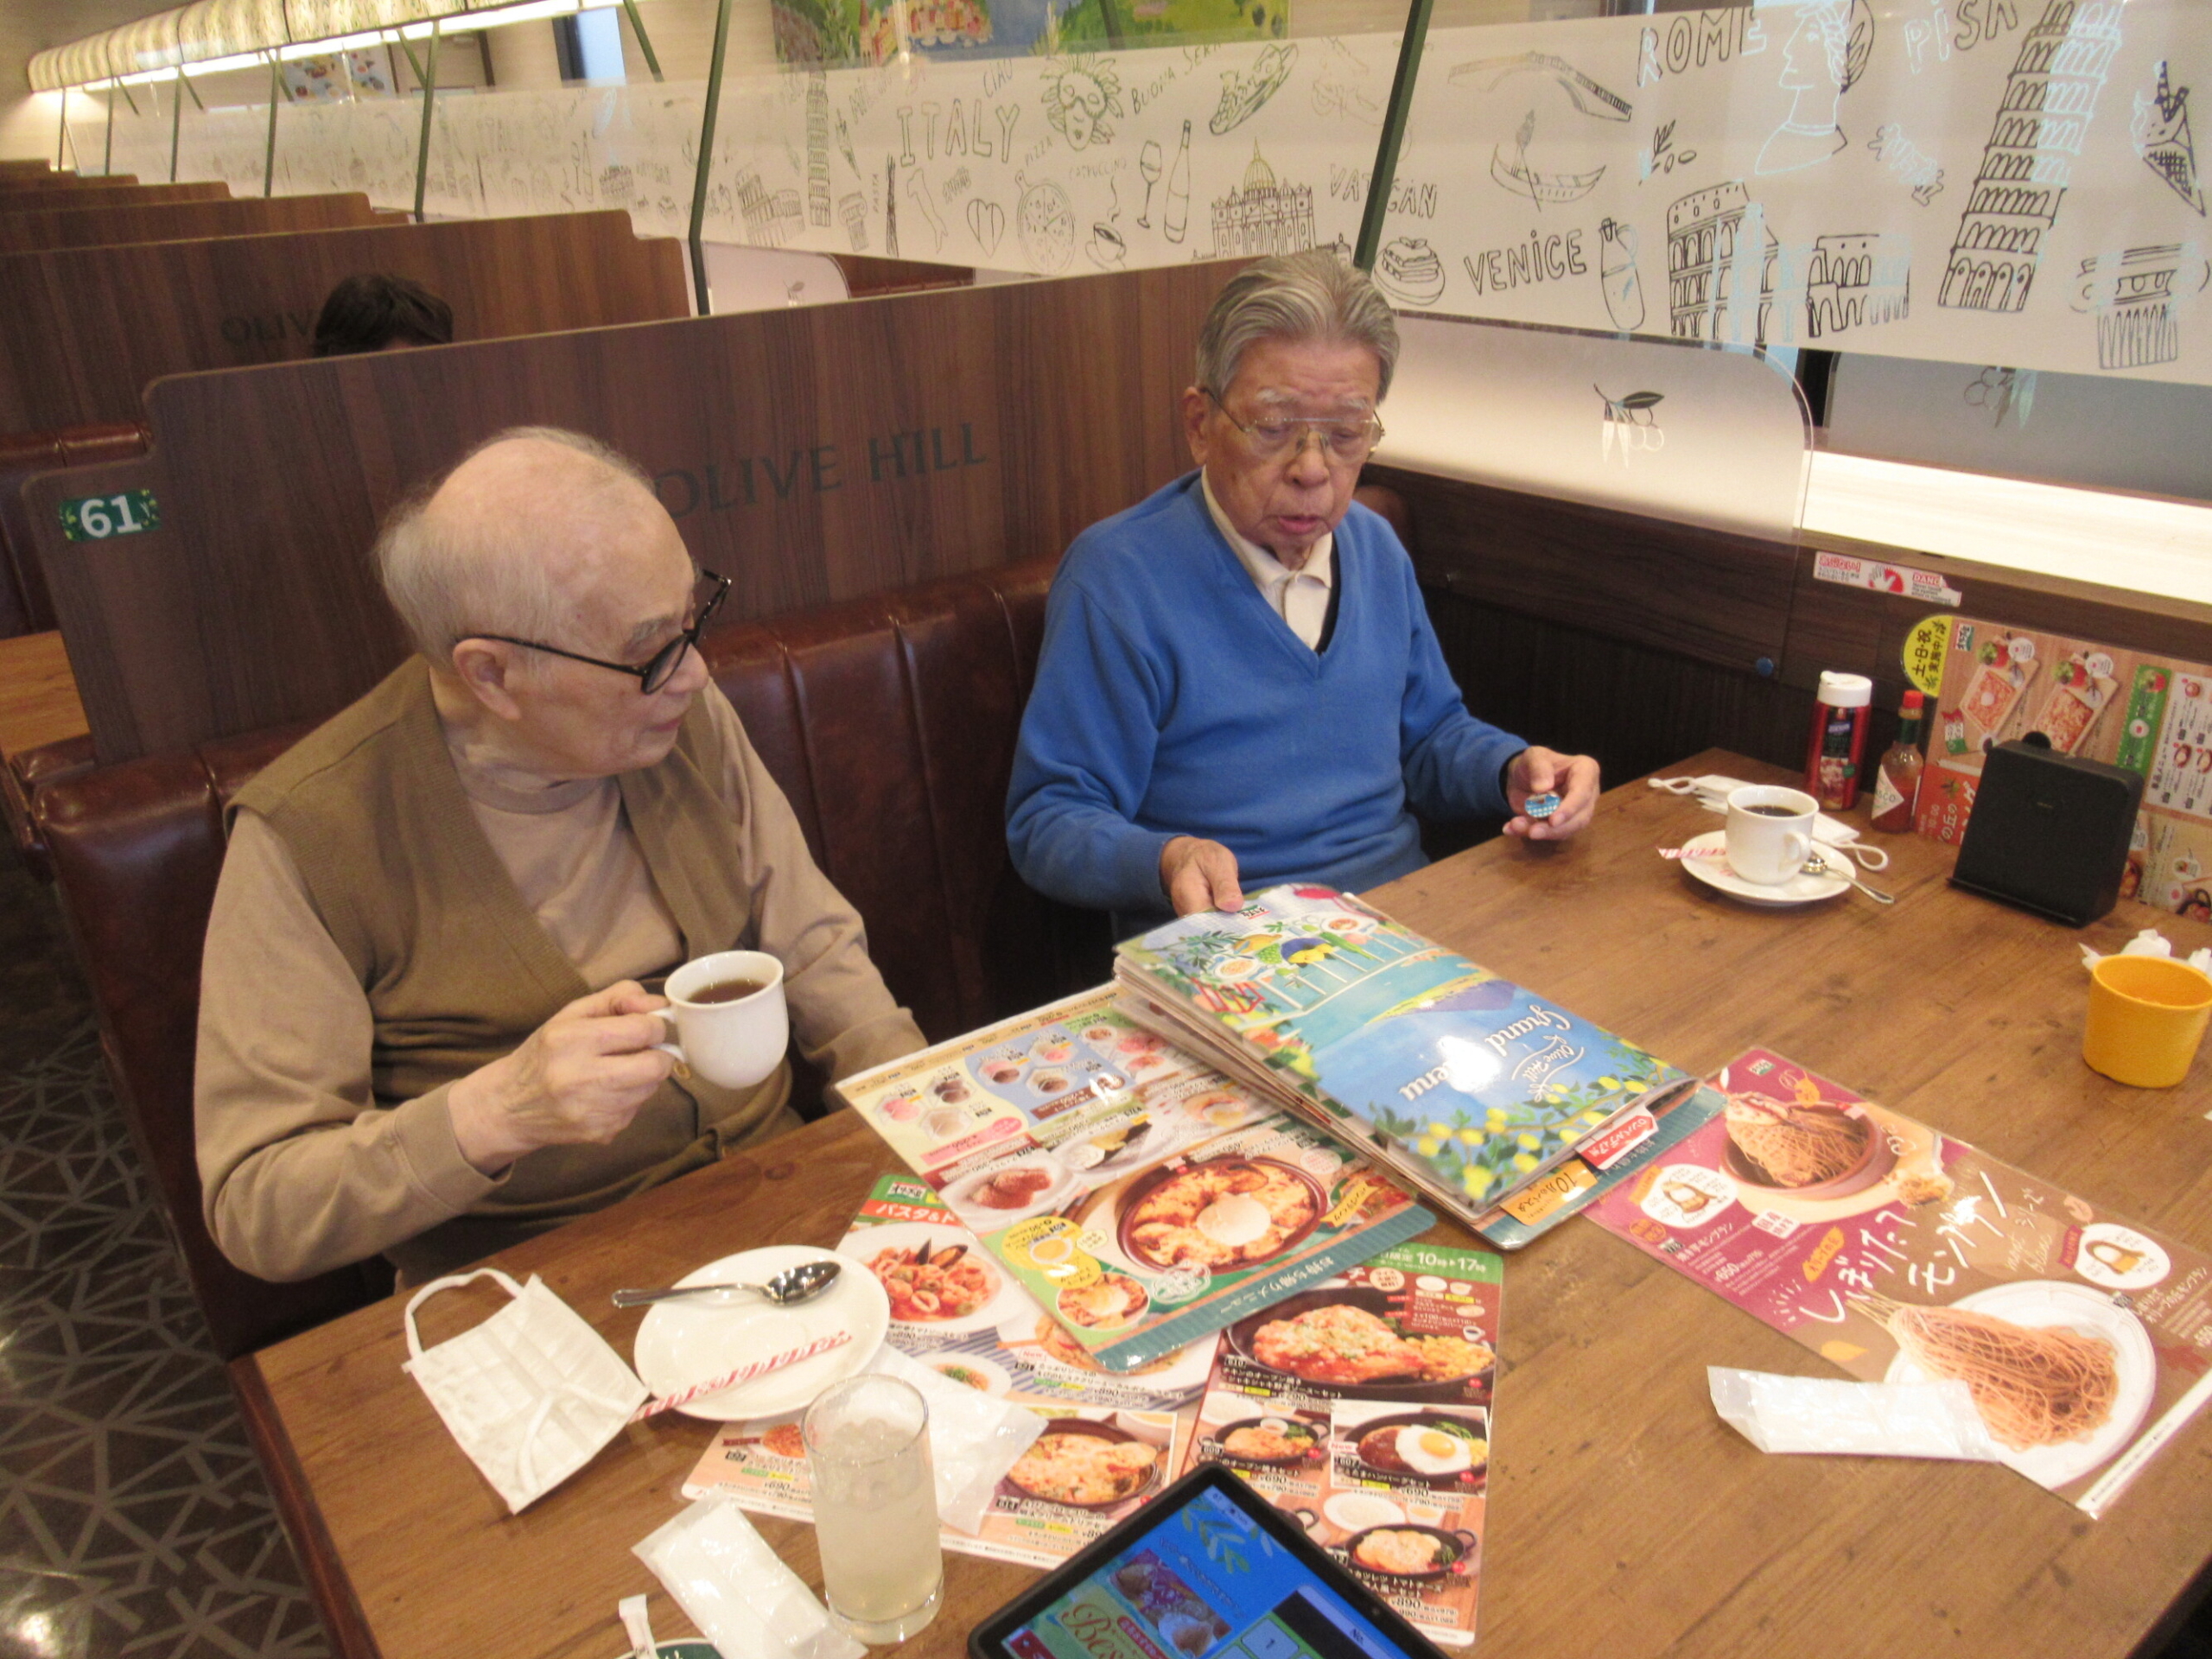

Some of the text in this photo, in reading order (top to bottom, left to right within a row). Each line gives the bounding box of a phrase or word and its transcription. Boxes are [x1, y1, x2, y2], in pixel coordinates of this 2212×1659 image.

[1637, 3, 1767, 87] ROME
[1904, 0, 2018, 75] PISA
[896, 98, 1021, 168] ITALY
[1024, 136, 1054, 167] PIZZA
[654, 422, 988, 520] OLIVE HILL
[80, 494, 143, 539] 61
[1484, 1004, 1572, 1058] Grand
[1219, 1256, 1335, 1314] お持ち帰りメニュー
[1391, 1596, 1421, 1610] ¥890
